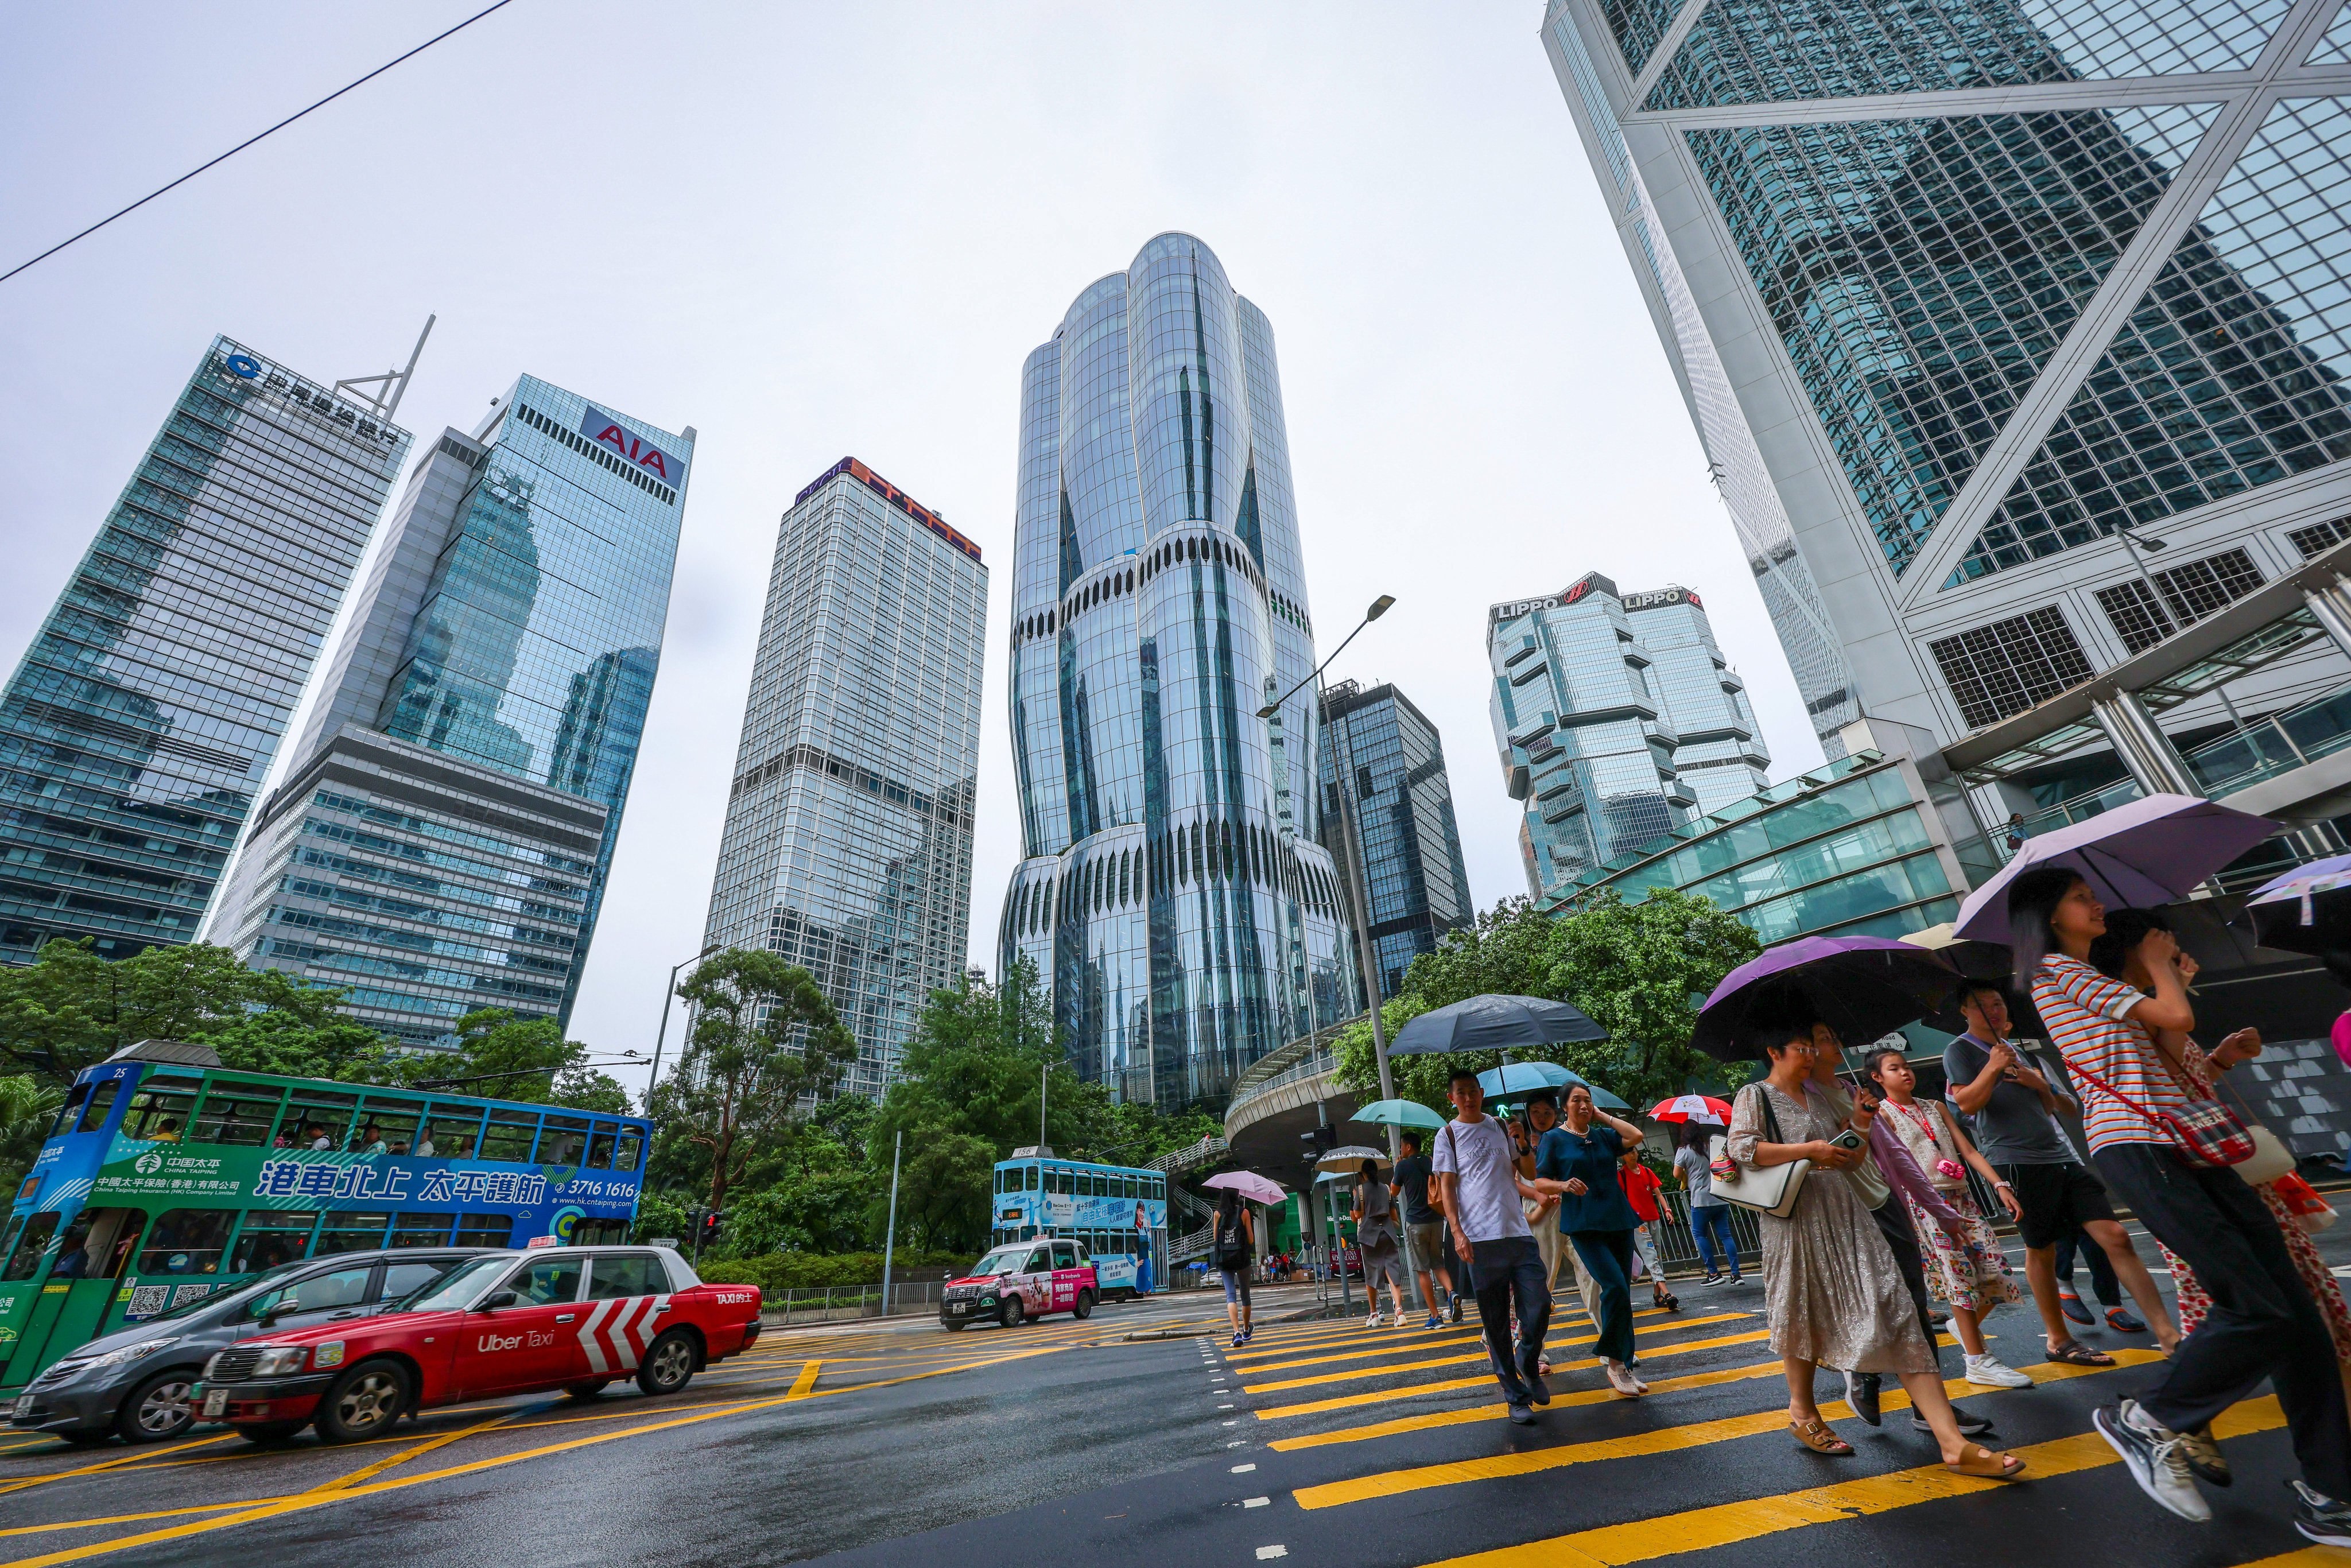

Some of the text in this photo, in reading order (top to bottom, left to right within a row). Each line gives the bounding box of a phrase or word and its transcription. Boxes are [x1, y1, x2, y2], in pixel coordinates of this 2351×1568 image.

[262, 381, 379, 444] China Construction Bank
[596, 425, 667, 479] AIA
[1499, 598, 1558, 619] LIPPO
[1625, 591, 1679, 609] LIPPO
[113, 1068, 128, 1078] 25
[1018, 1147, 1031, 1156] 156
[1466, 1147, 1505, 1159] VALENTON
[166, 1157, 222, 1168] 中国太平
[253, 1159, 547, 1205] 港車北上 太平護航
[568, 1179, 635, 1197] 3716 1616
[560, 1197, 631, 1209] www.hk.cntaiping.com
[715, 1293, 752, 1305] TAXI 的士
[477, 1329, 555, 1352] Uber Taxi
